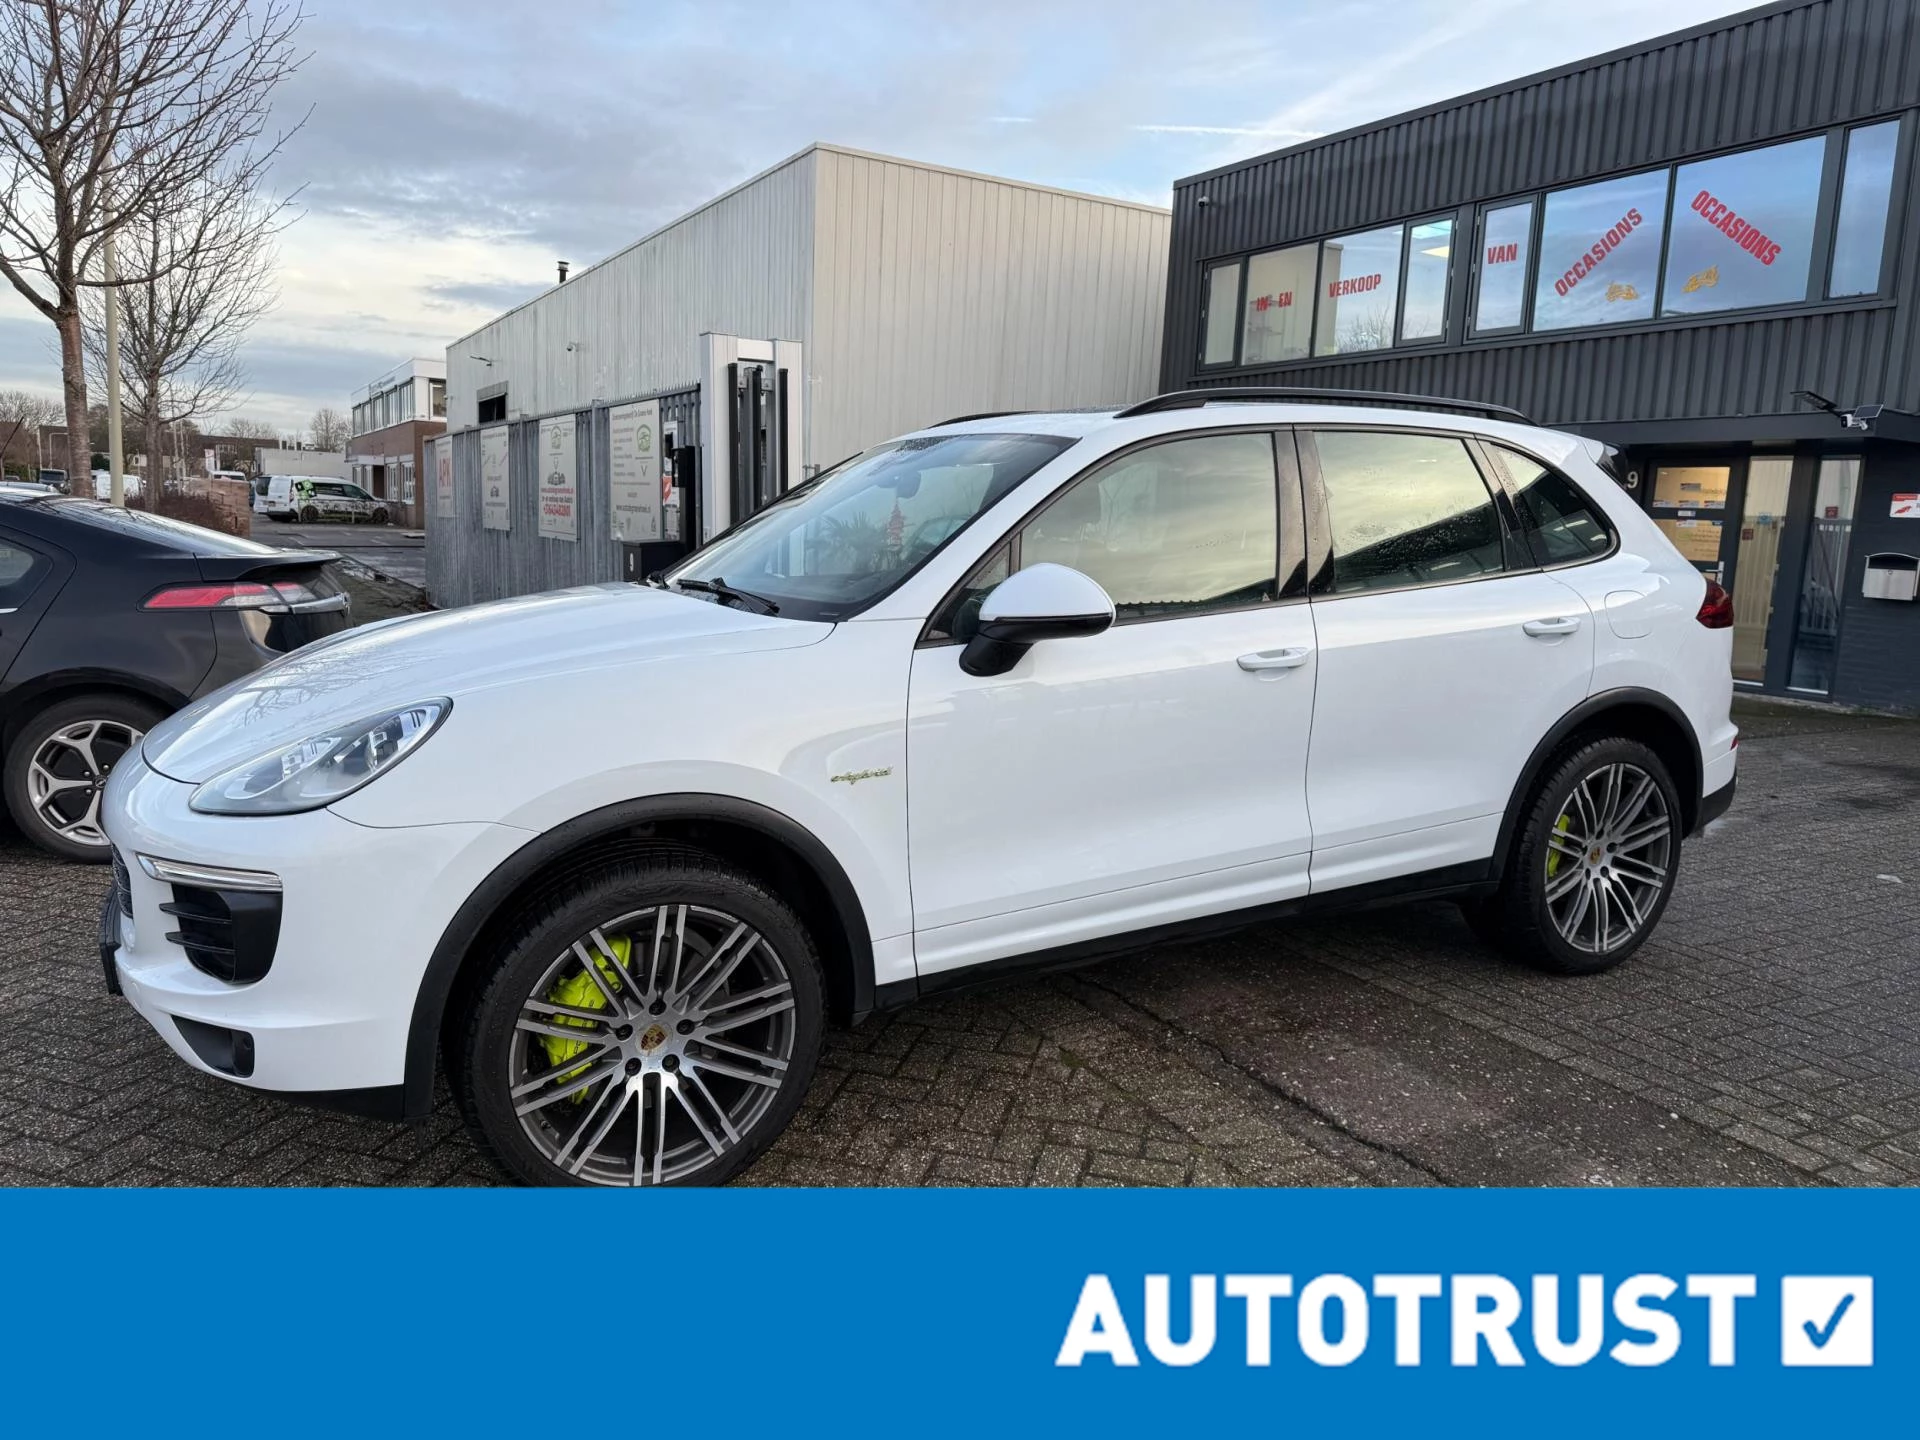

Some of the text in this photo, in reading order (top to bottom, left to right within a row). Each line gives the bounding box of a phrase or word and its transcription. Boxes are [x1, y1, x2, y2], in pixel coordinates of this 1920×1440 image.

[1554, 207, 1643, 297] OCCASIONS
[1692, 190, 1782, 266] OCCASIONS
[1279, 290, 1292, 308] EN
[1328, 274, 1382, 298] VERKOOP
[1487, 243, 1518, 265] VAN
[1627, 471, 1639, 489] 9
